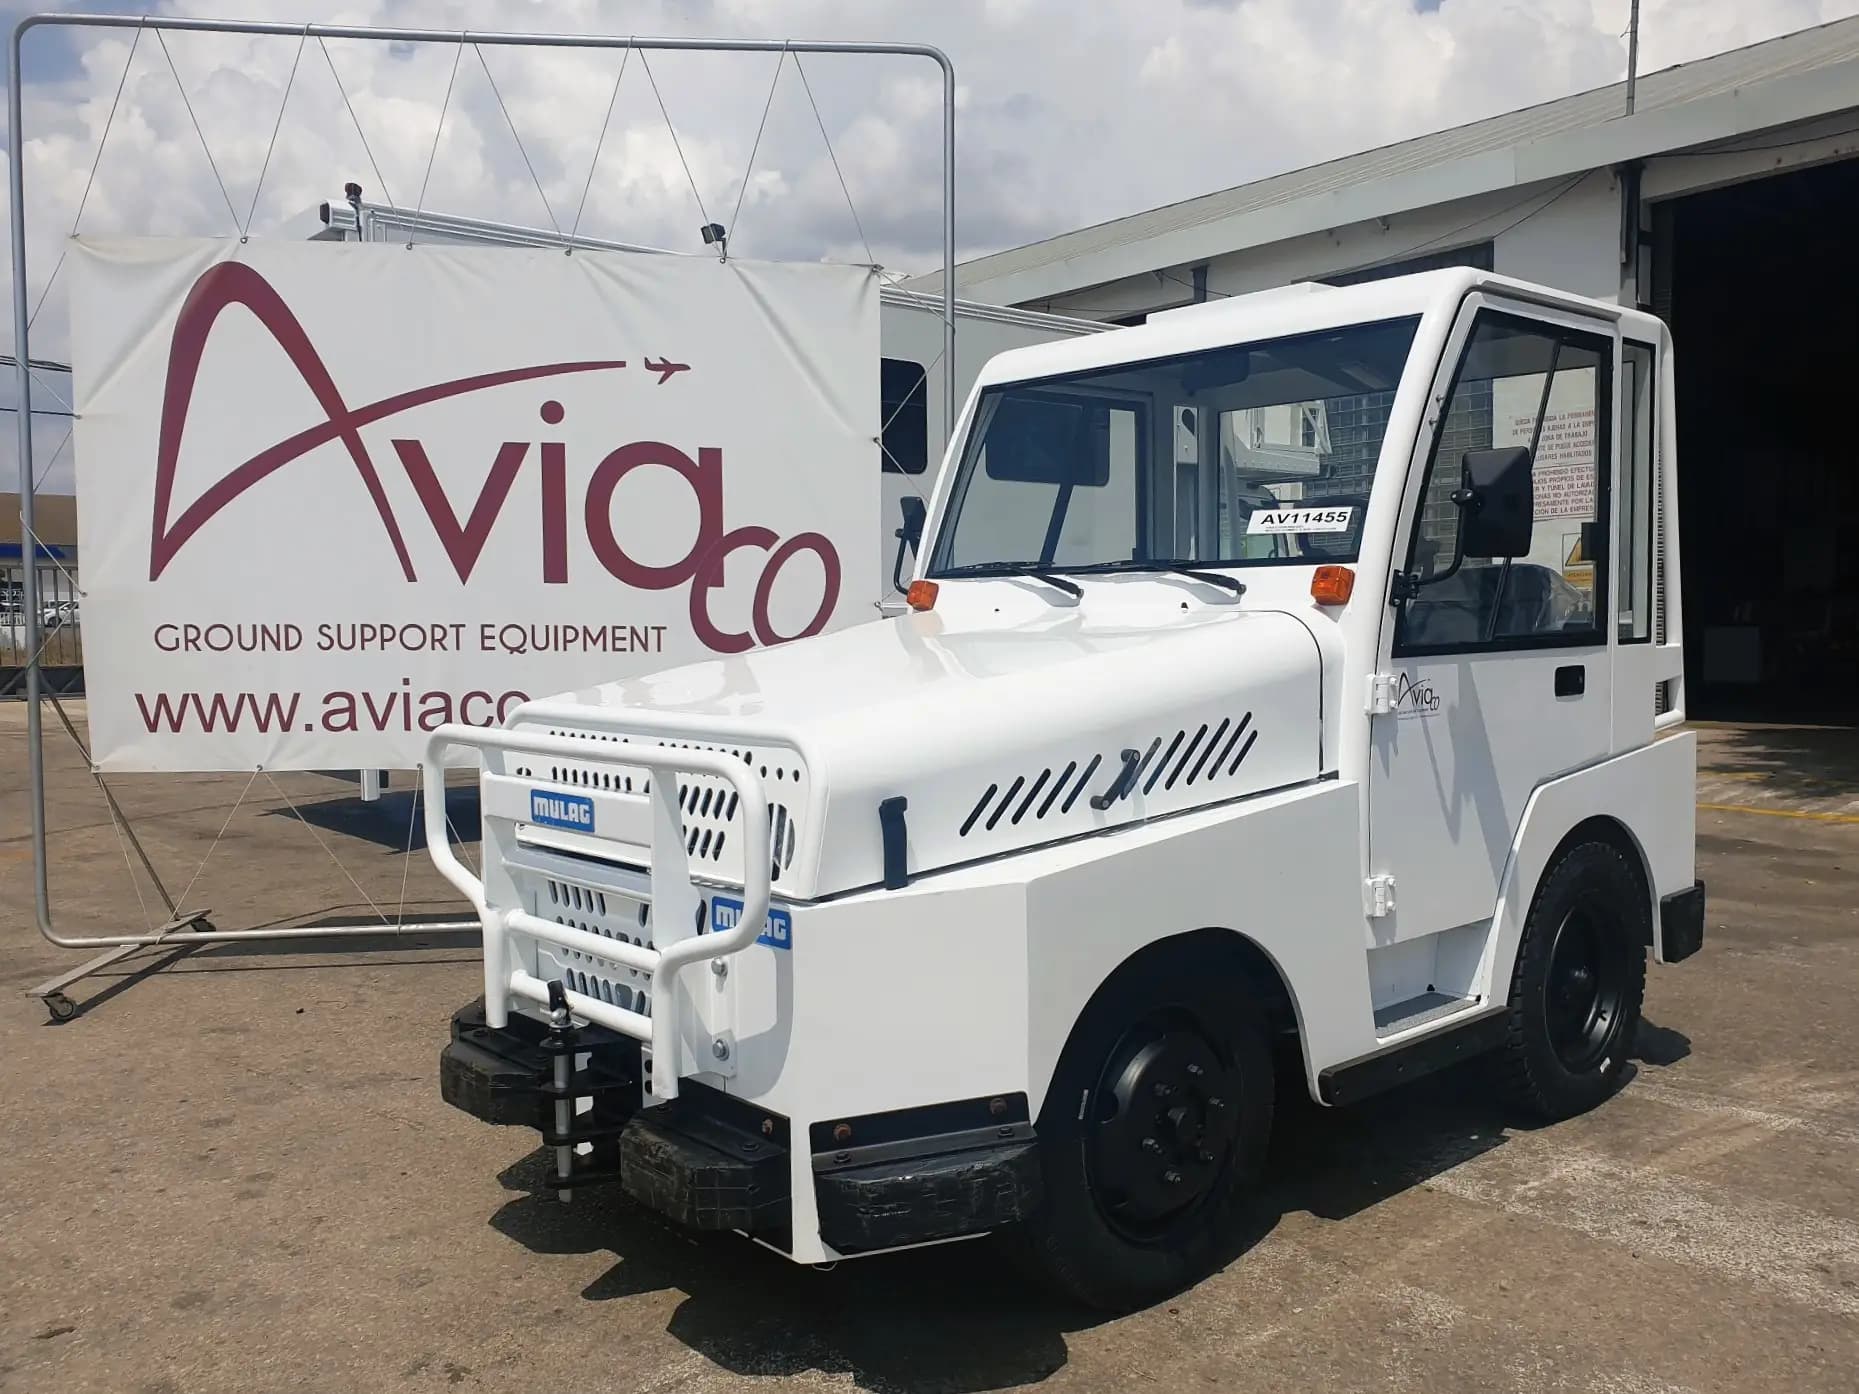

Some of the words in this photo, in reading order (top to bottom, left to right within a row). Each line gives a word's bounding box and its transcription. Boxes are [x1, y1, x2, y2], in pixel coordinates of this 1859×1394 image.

[1260, 511, 1348, 525] AV11455
[154, 624, 303, 653] GROUND
[317, 624, 465, 653] SUPPORT
[480, 625, 667, 655] EQUIPMENT
[533, 796, 591, 825] MULAG
